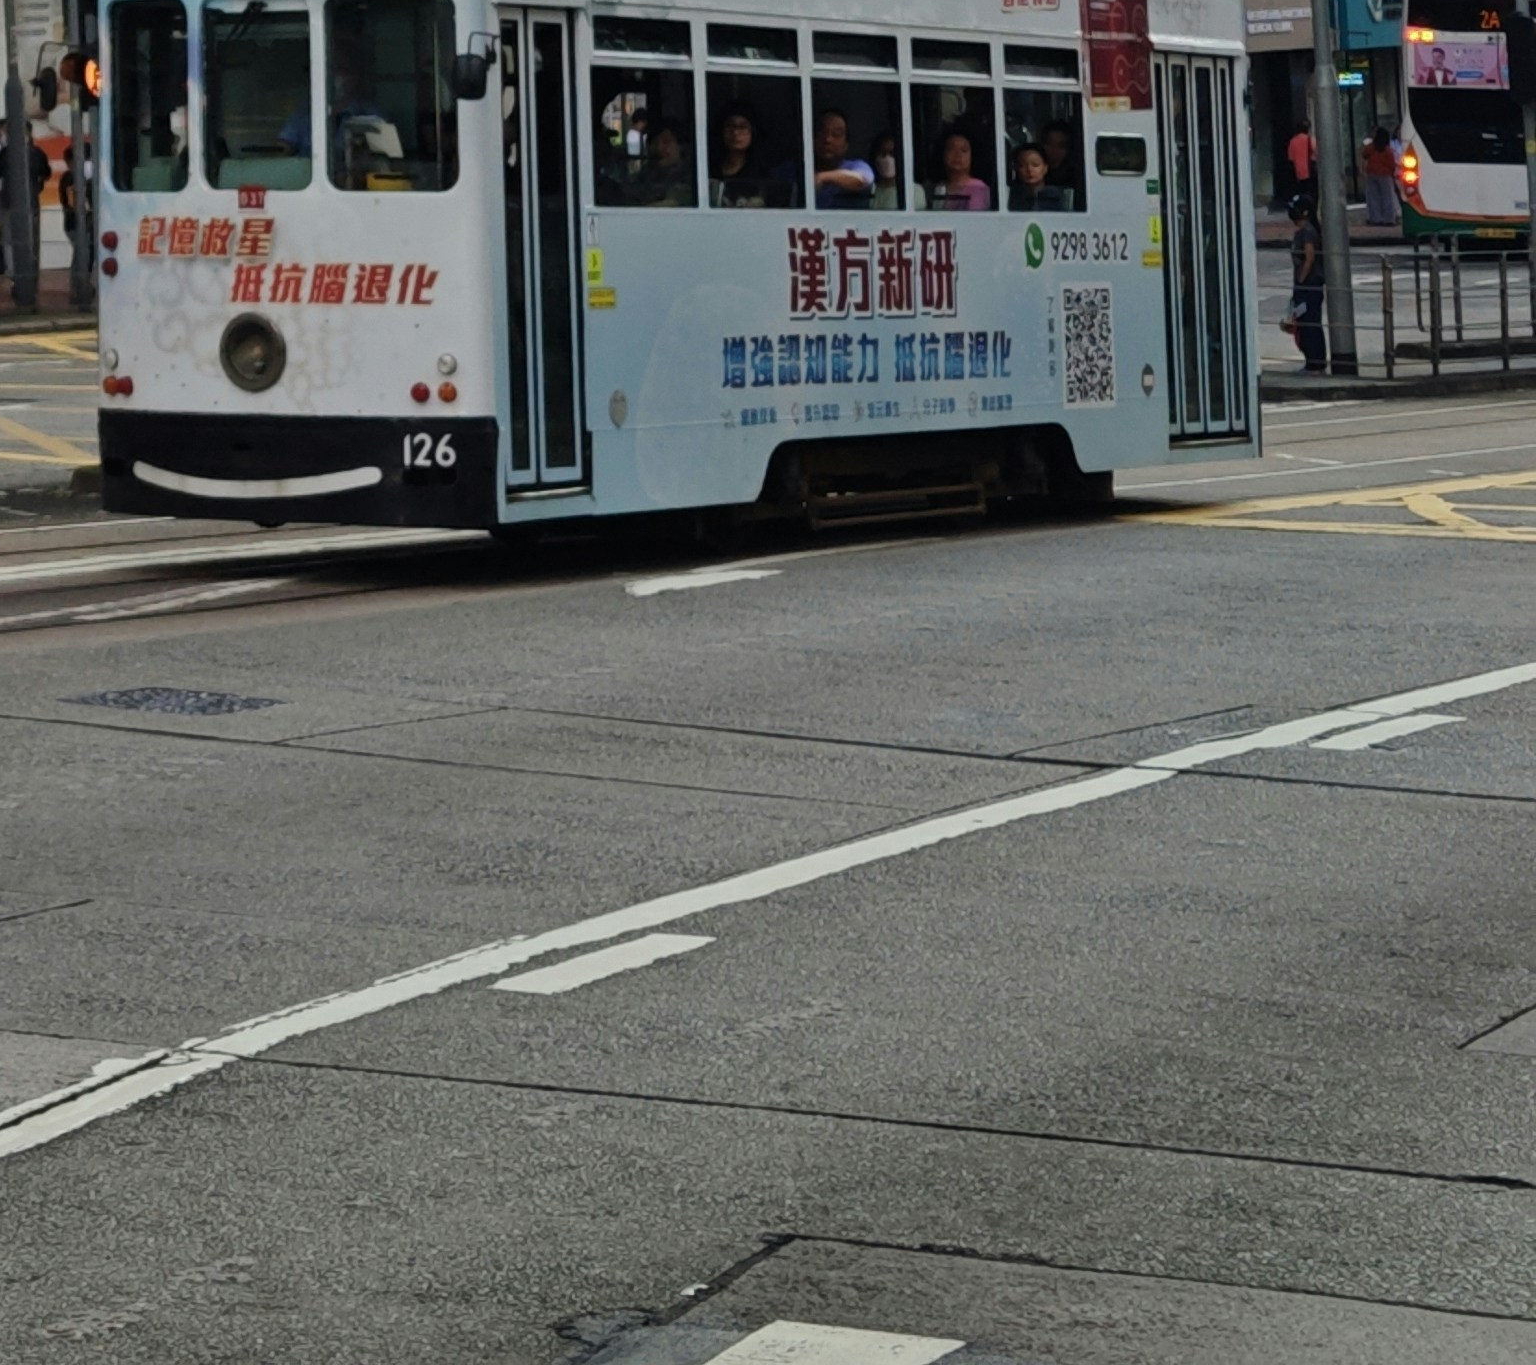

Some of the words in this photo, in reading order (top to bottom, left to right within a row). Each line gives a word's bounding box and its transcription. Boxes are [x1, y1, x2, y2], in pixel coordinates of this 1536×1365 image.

[1480, 10, 1501, 29] 2A
[138, 218, 274, 257] 記憶救星
[1051, 232, 1087, 261] 9298
[1093, 232, 1128, 261] 3612
[231, 263, 439, 305] 抵抗腦退化
[788, 228, 956, 313] 漢方新研
[723, 334, 879, 388] 增強認知能力
[895, 331, 1011, 382] 抵抗腦退化
[403, 433, 456, 467] 126
